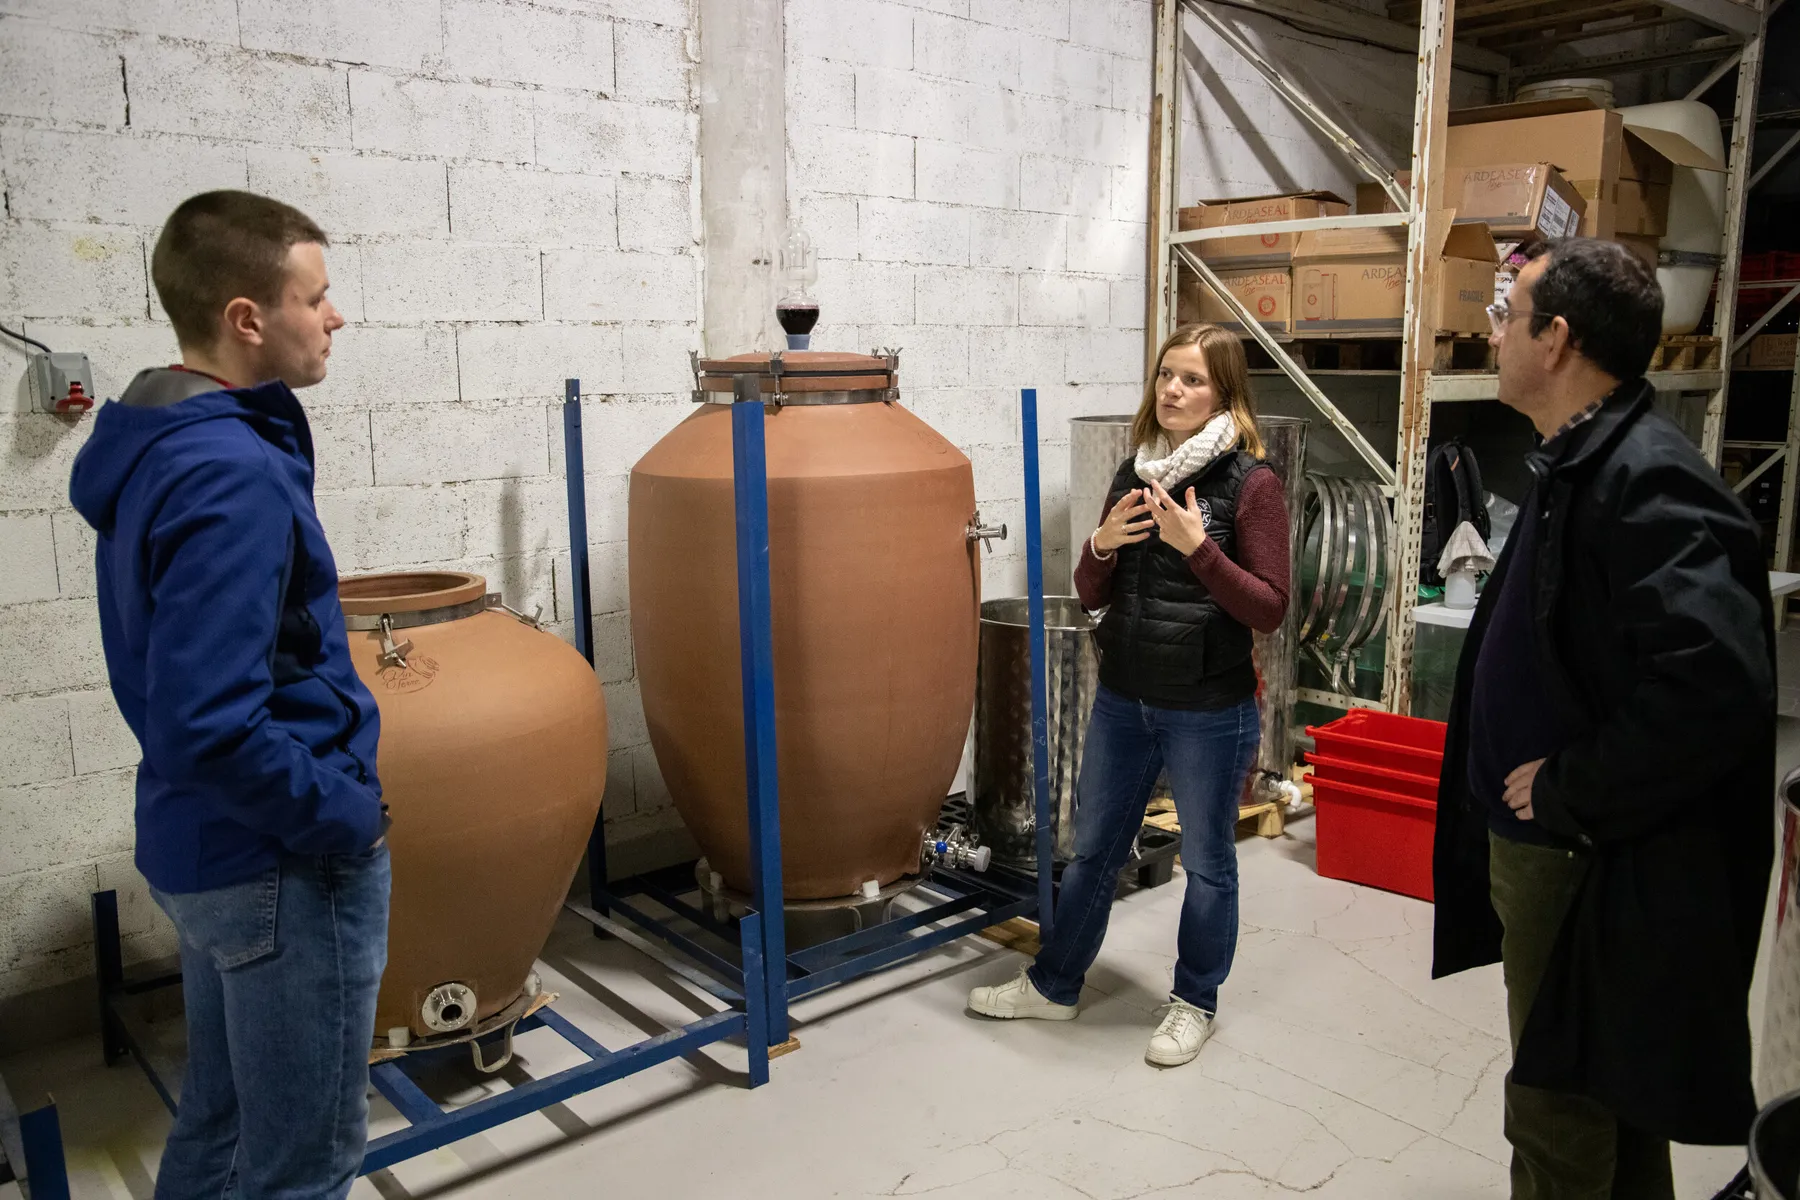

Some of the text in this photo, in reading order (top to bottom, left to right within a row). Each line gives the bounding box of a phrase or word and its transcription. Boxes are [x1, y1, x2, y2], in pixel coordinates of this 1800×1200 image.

[1464, 168, 1538, 182] ARDEASE
[1224, 273, 1286, 287] ARDEASEAL
[1460, 290, 1484, 302] FRAGILE
